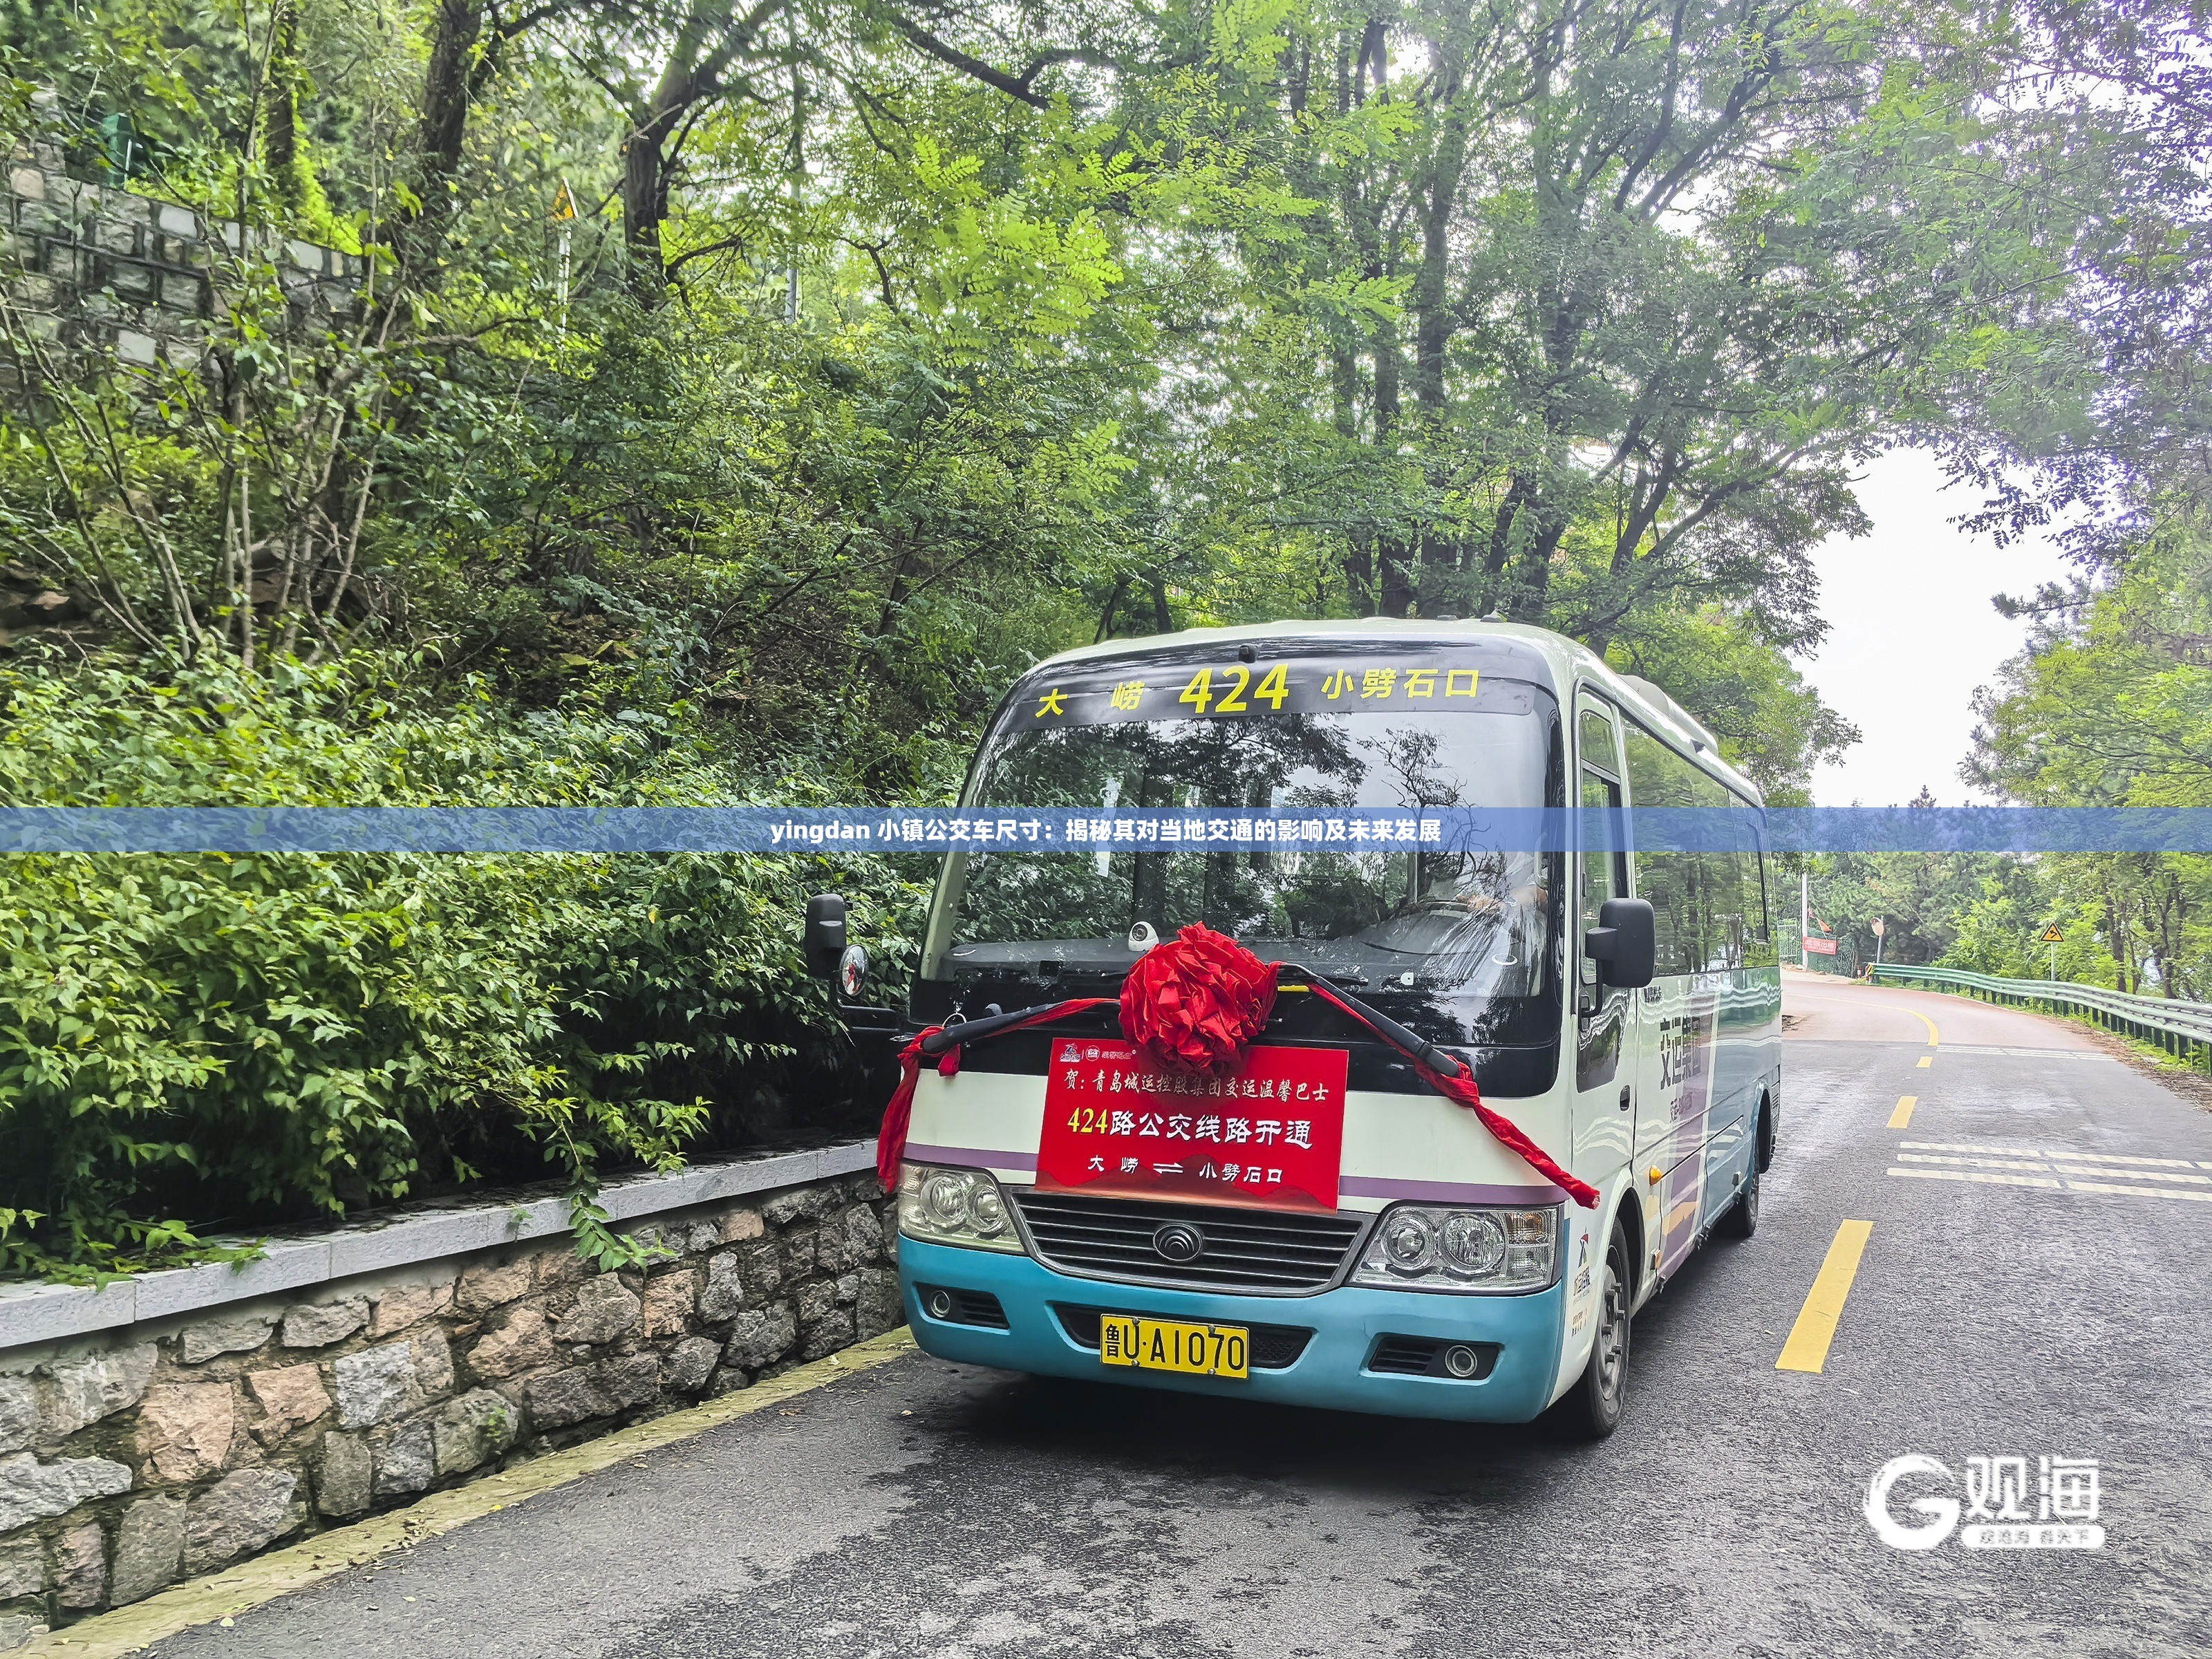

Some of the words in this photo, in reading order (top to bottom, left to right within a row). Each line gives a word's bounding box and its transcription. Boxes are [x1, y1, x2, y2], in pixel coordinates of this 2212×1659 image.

[1035, 688, 1069, 720] 大
[1111, 680, 1149, 711] 崂
[1179, 663, 1290, 715] 424
[1320, 667, 1480, 701] 小劈石口
[1067, 1107, 1313, 1150] 424路公交线路开通
[1087, 1154, 1105, 1173] 大
[1120, 1156, 1139, 1175] 崂
[1198, 1161, 1284, 1184] 小劈石口
